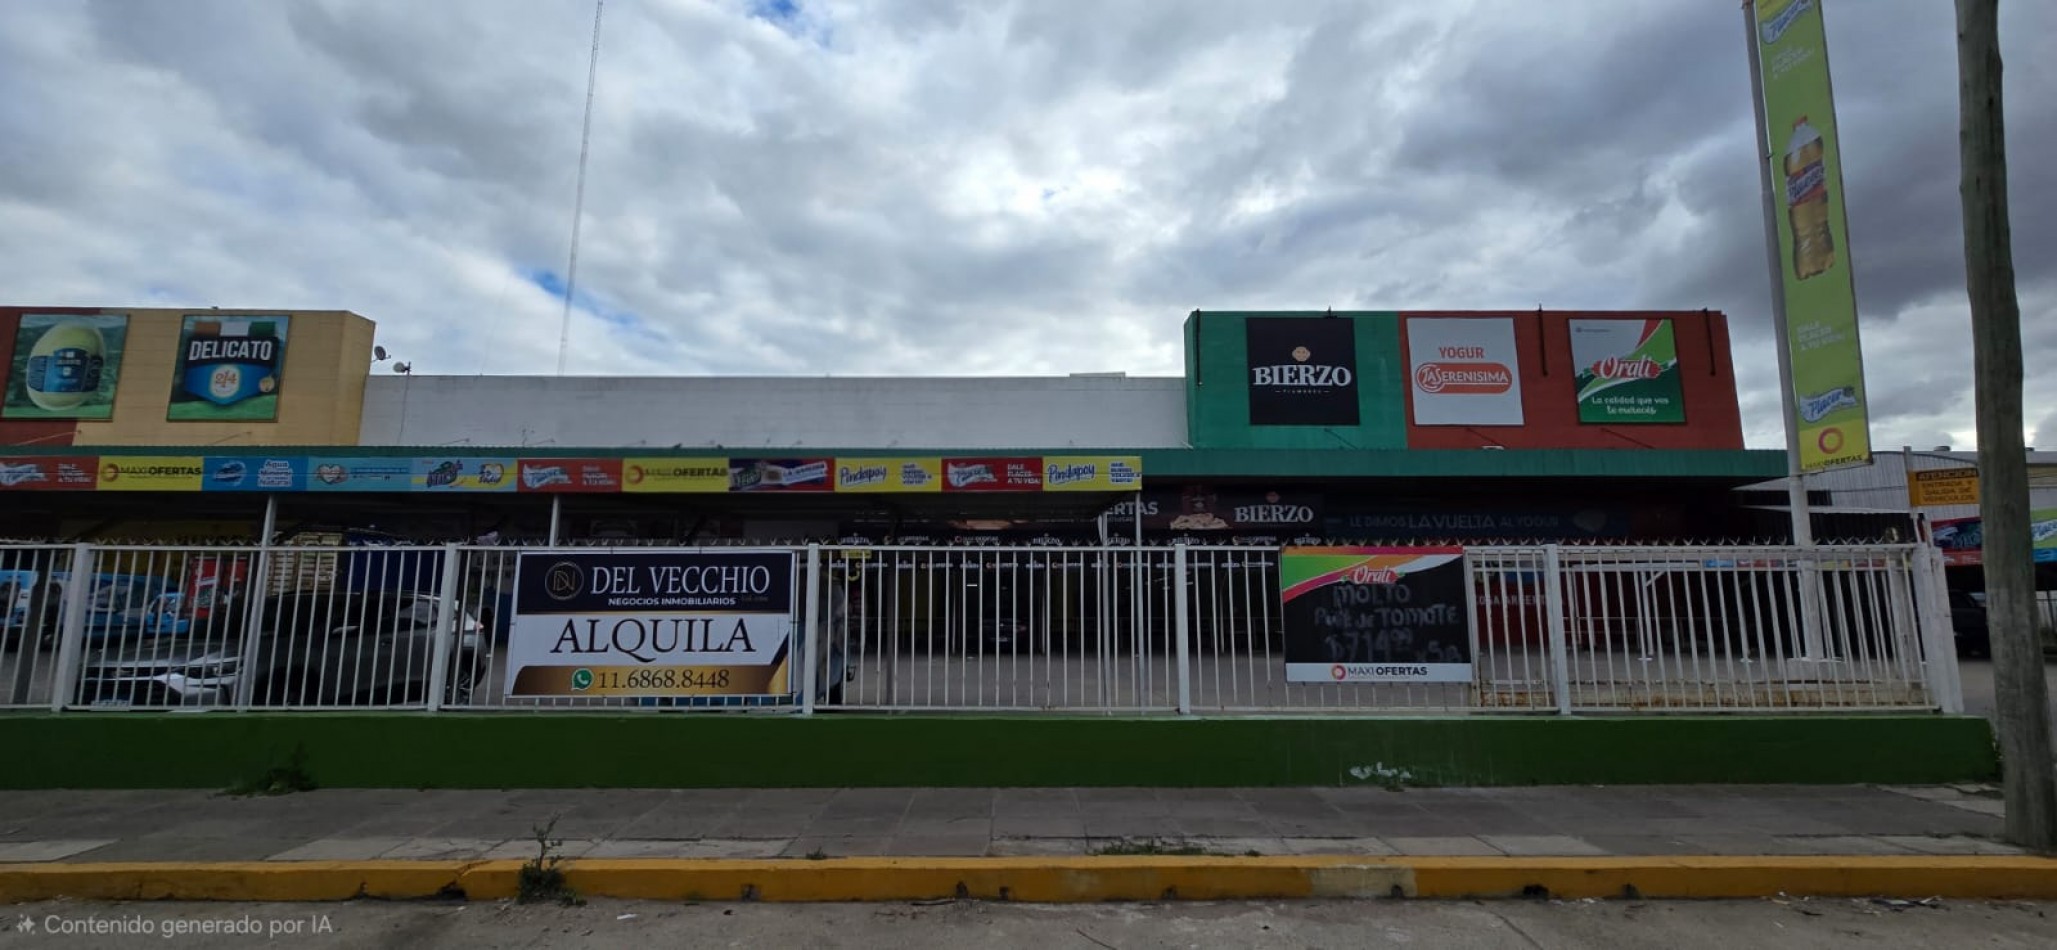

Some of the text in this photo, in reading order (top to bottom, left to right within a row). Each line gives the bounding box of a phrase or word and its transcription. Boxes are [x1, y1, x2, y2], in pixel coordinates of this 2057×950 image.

[188, 341, 272, 360] DELICATO
[1438, 347, 1485, 358] YOGUR
[1252, 364, 1352, 387] BIERZO
[1599, 354, 1653, 380] Orali
[1234, 505, 1314, 523] BIERZO
[1432, 515, 1496, 528] VUELTA
[590, 565, 770, 595] DEL VECCHIO
[1353, 565, 1392, 585] Orali
[608, 597, 659, 607] NEGOCIOS
[661, 597, 736, 606] INMOBILIARIOS
[1333, 584, 1411, 606] MOLTO
[550, 618, 756, 663] ALQUILA
[598, 669, 730, 690] 11.6868.8448
